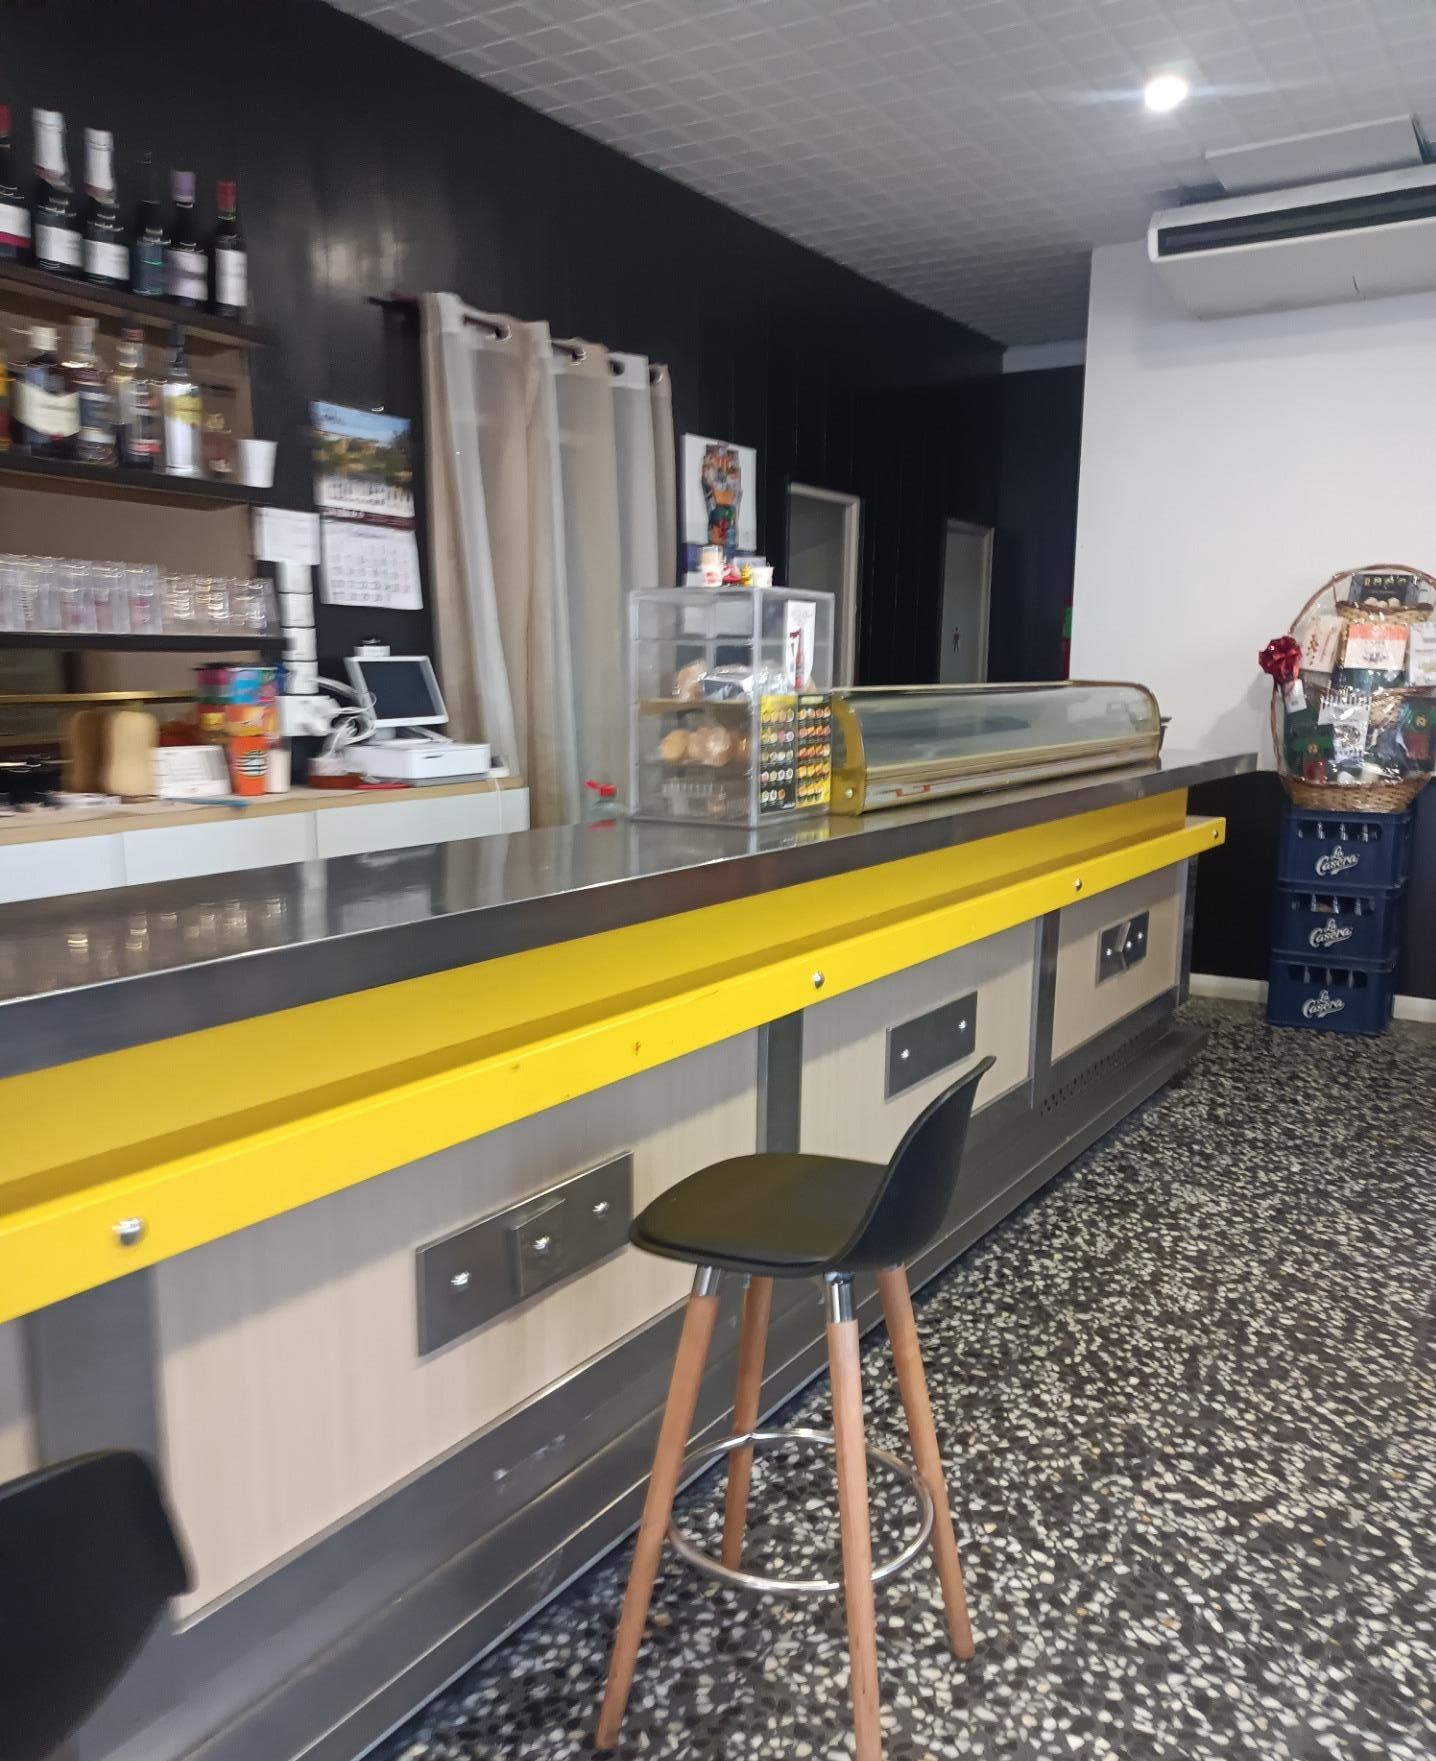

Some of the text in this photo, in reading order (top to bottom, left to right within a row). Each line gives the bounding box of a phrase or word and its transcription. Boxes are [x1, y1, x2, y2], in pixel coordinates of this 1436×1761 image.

[1332, 845, 1344, 859] La
[1315, 853, 1359, 876] Casera
[1326, 917, 1337, 932] La
[1309, 926, 1352, 947] Casera
[1319, 989, 1330, 1003] La
[1302, 998, 1344, 1018] Casera
